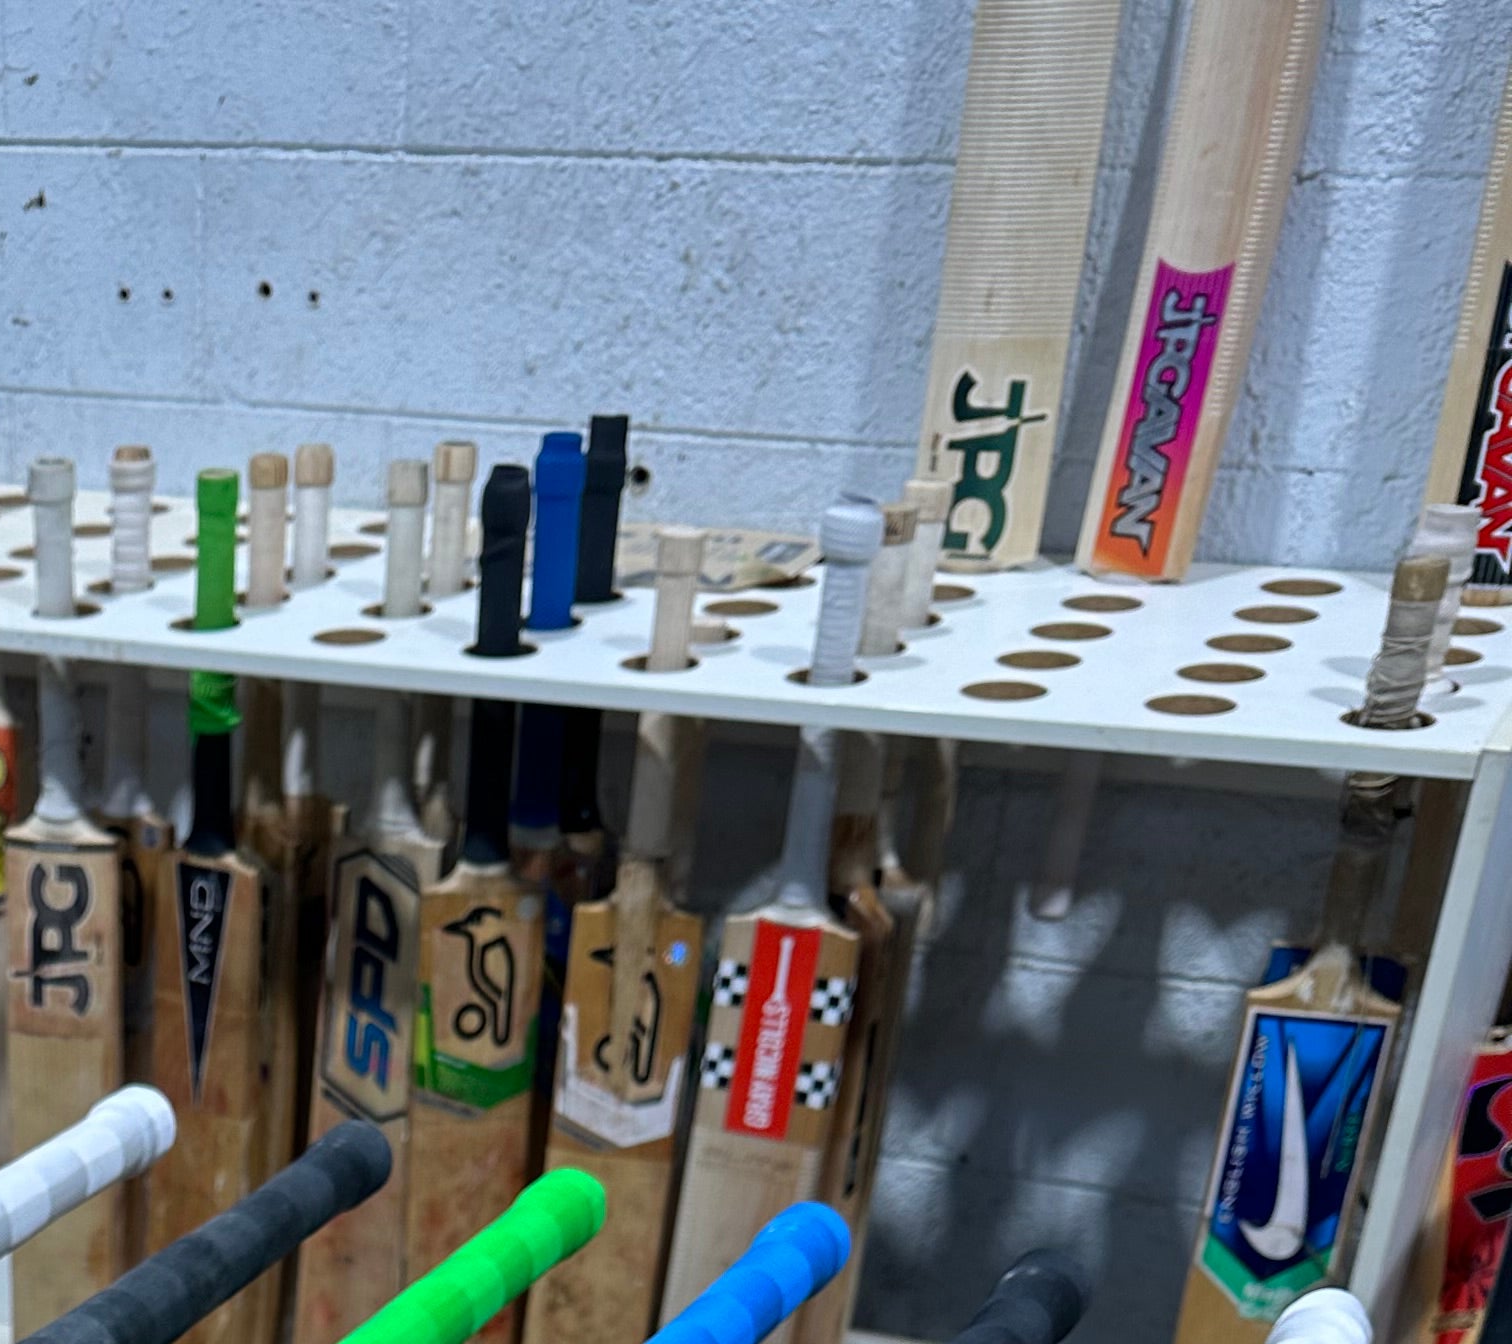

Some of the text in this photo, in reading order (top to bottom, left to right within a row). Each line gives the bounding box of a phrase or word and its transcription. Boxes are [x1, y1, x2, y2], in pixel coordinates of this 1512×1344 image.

[941, 370, 1048, 552] JPG
[1110, 286, 1217, 558] JPGAVAN
[8, 860, 93, 1019] JPG
[346, 876, 399, 1090] SPD
